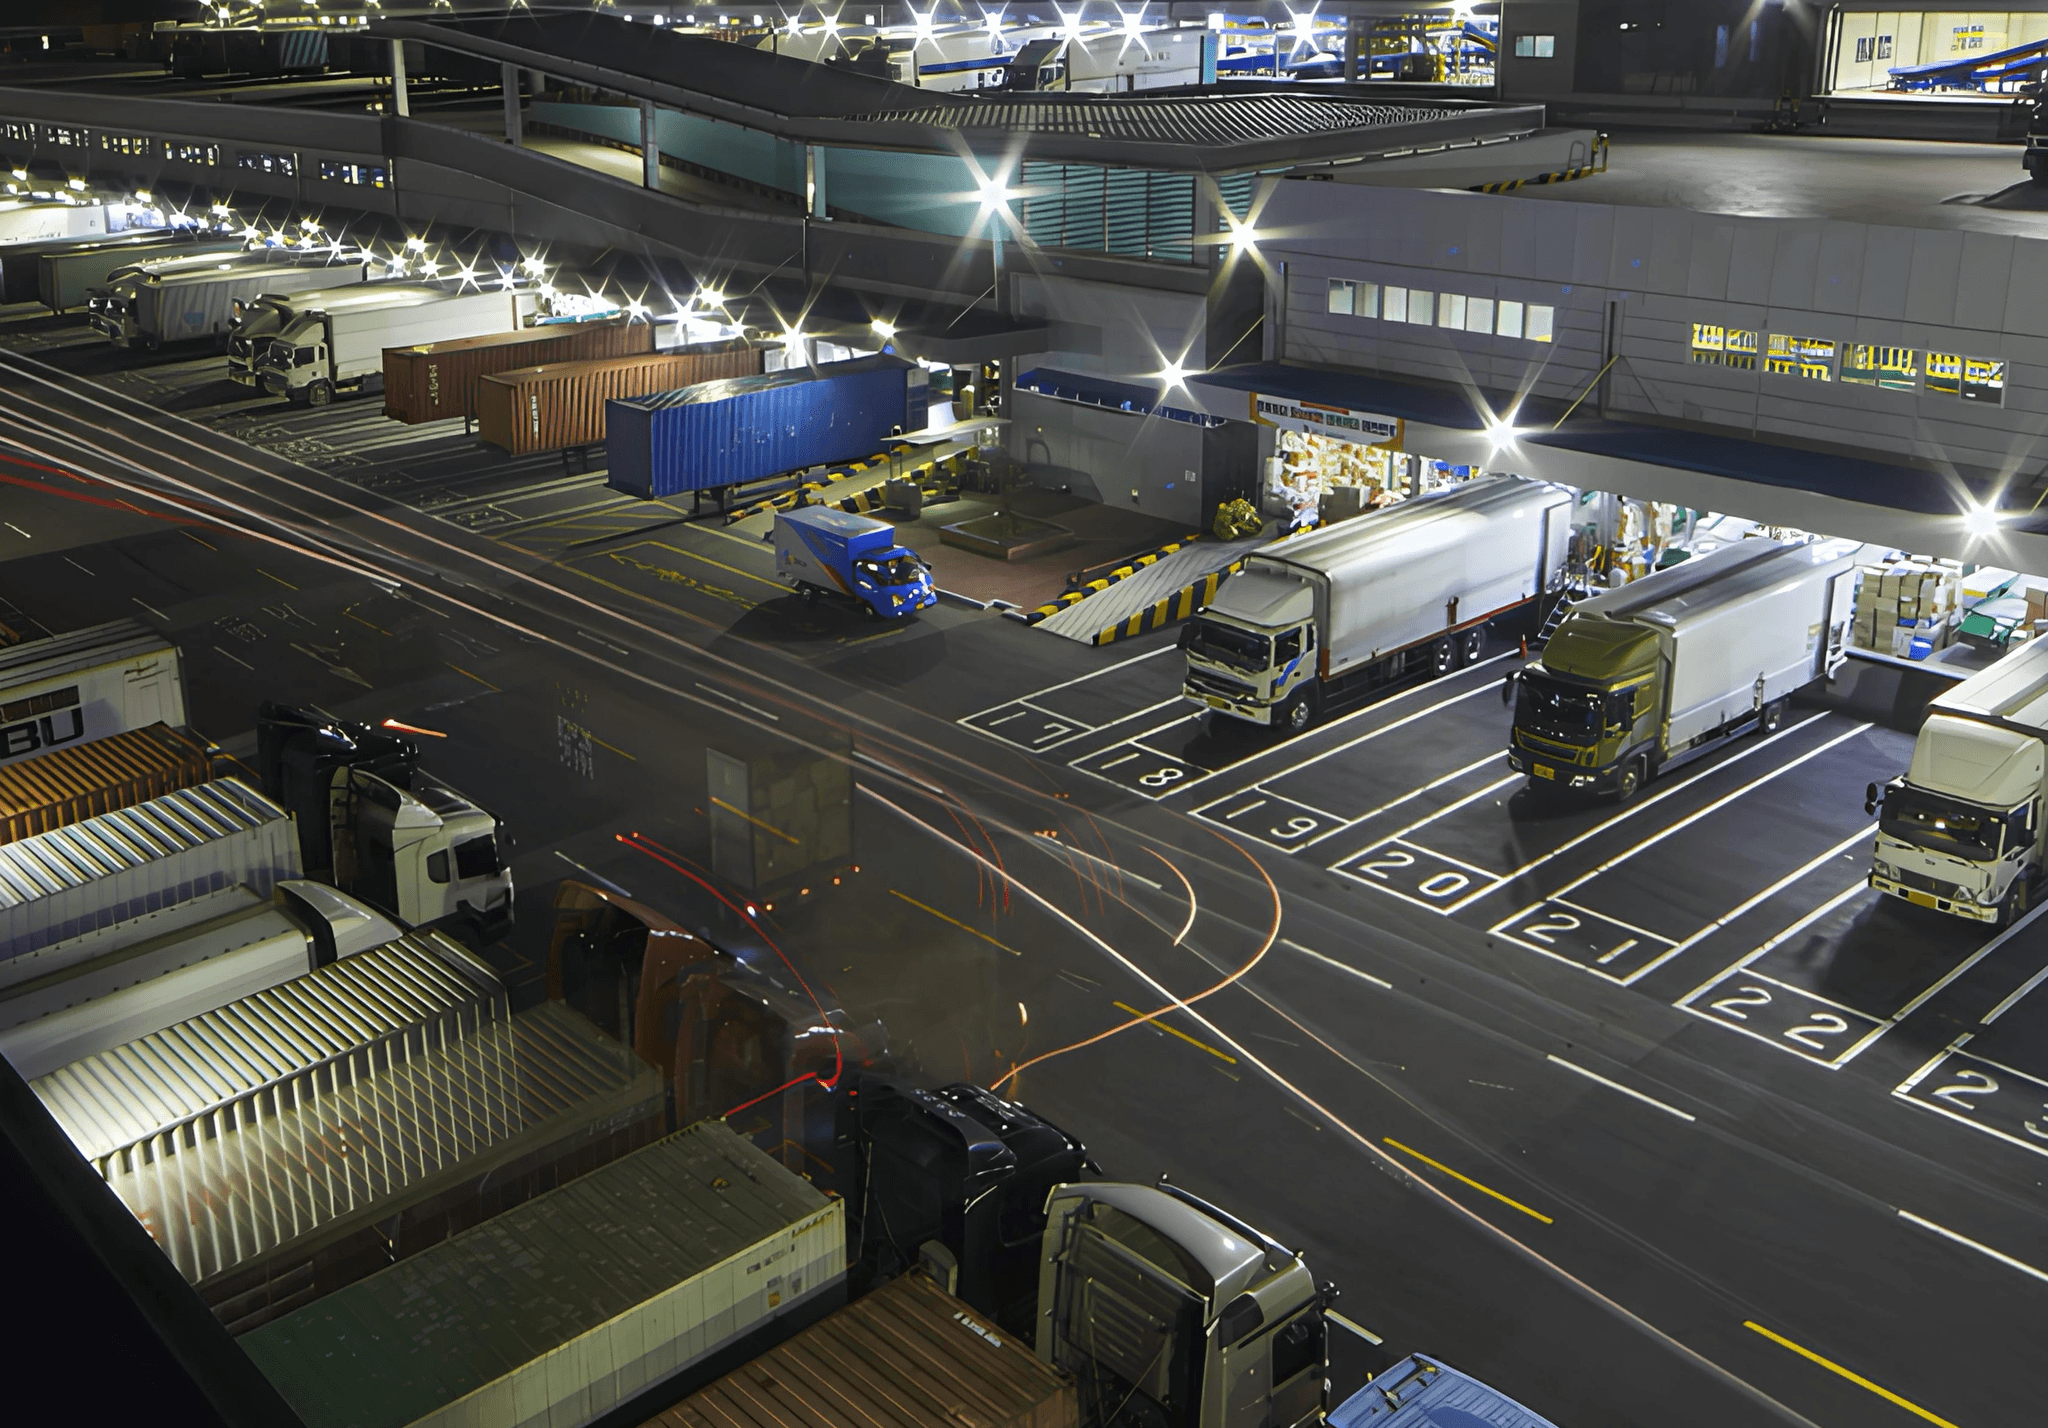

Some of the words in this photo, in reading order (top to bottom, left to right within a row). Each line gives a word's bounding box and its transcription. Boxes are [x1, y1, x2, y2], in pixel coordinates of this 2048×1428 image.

[989, 711, 1073, 745] 17
[1100, 753, 1184, 787] 18
[1225, 800, 1318, 839] 19
[1358, 851, 1470, 897] 20
[1523, 913, 1639, 964] 21
[1711, 986, 1848, 1049] 22
